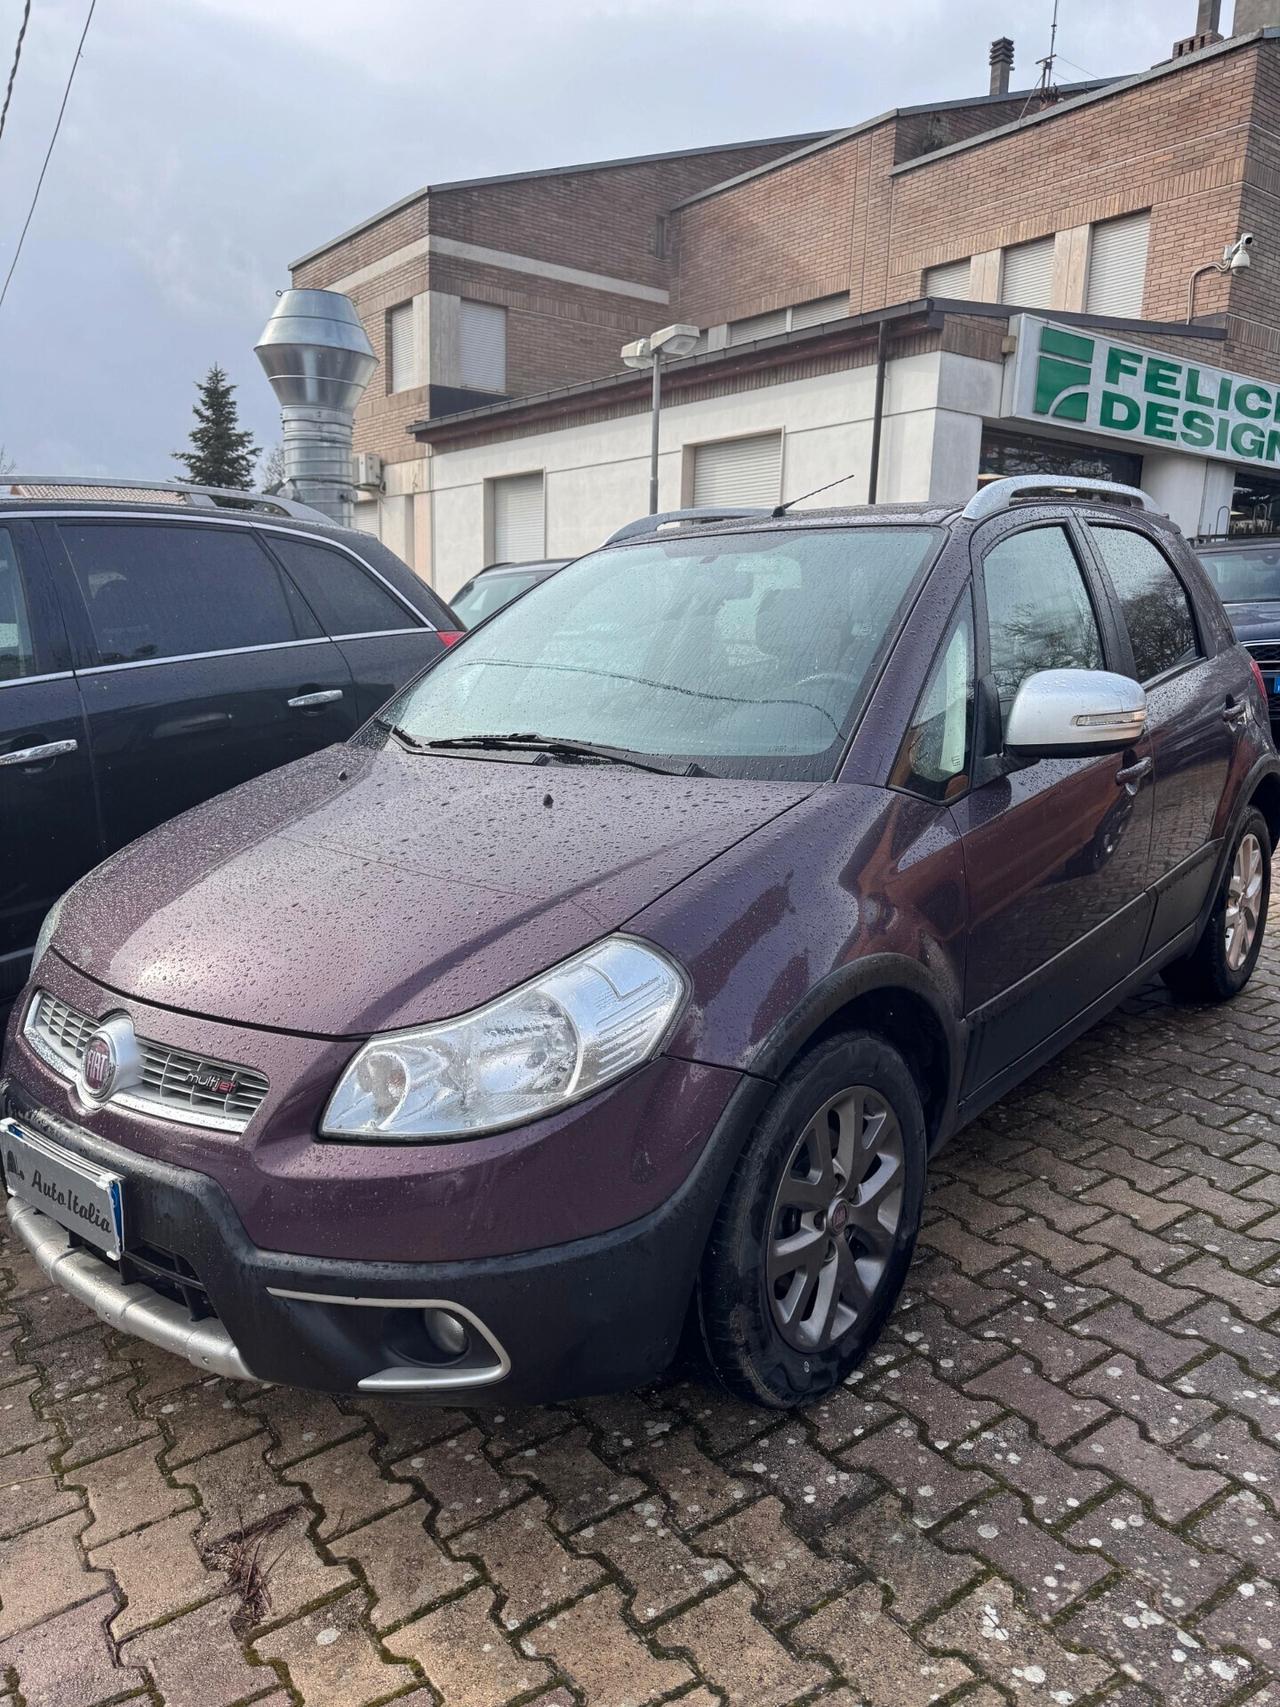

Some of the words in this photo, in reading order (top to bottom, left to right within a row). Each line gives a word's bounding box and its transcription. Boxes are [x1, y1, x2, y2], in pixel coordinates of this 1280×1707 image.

[1105, 346, 1280, 423] FELIC
[86, 1049, 108, 1082] FIAT
[183, 1072, 237, 1093] multijet
